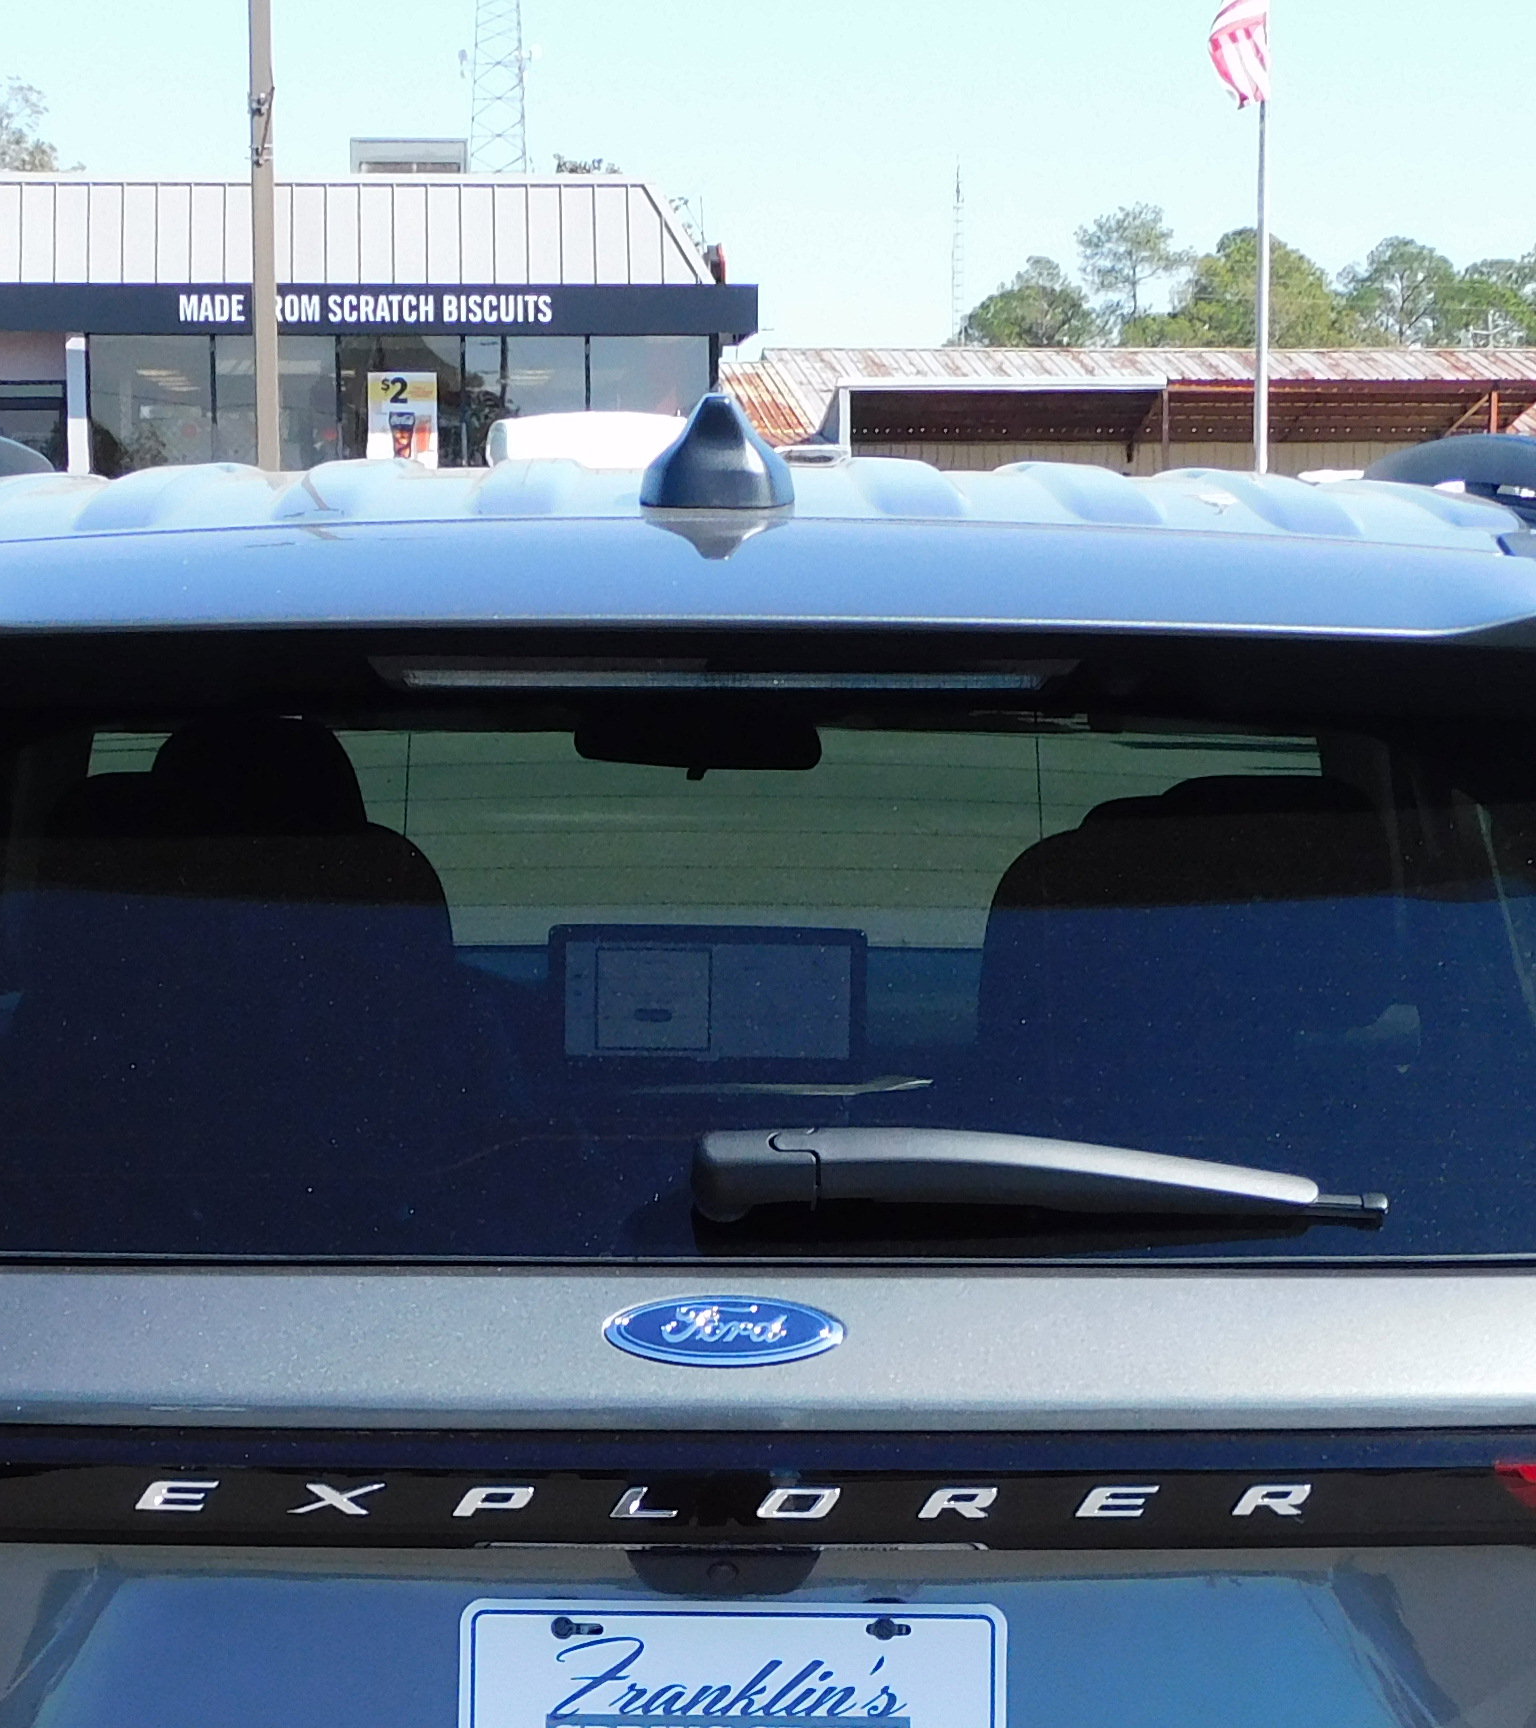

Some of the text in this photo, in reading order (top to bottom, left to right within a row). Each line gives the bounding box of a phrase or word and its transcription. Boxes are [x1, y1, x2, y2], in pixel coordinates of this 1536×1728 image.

[178, 294, 553, 324] MADE ROM SCRATCH BISCUITS
[380, 376, 409, 404] $2
[661, 1304, 789, 1343] Ford
[135, 1479, 1312, 1519] EXPLORER
[547, 1636, 908, 1720] Franklin's
